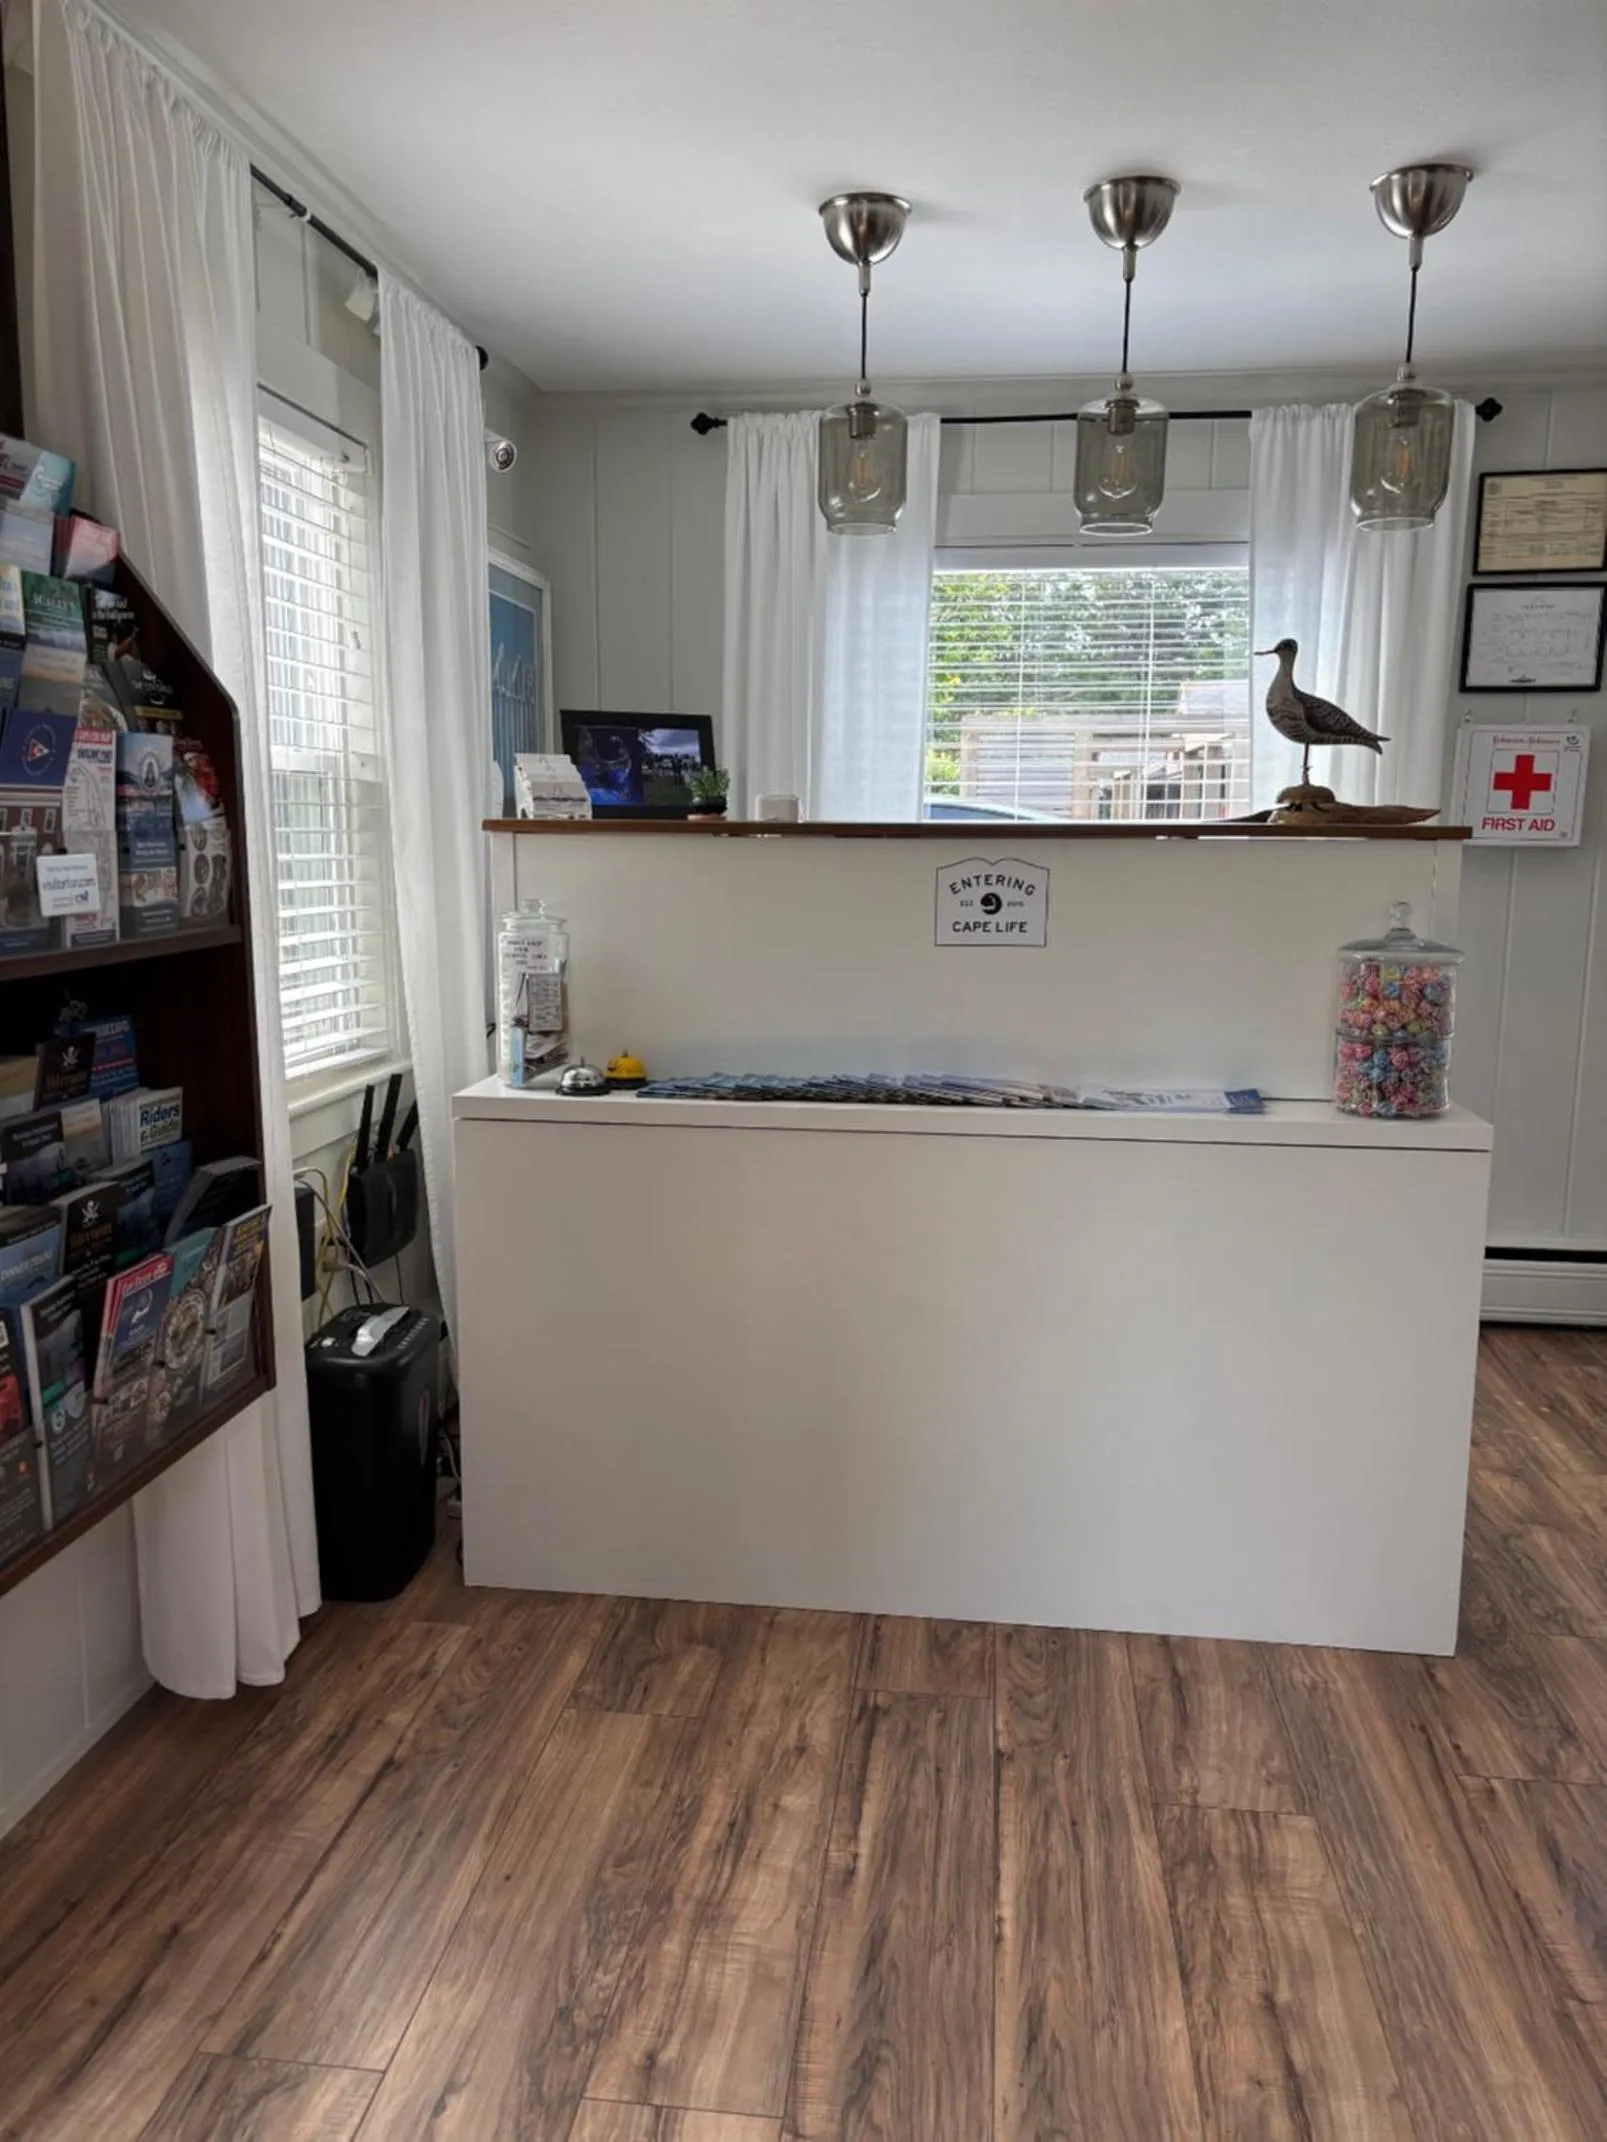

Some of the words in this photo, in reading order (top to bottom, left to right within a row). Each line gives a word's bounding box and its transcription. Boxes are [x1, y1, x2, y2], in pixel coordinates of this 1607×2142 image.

[1481, 817, 1526, 832] FIRST
[1528, 817, 1556, 832] AID
[949, 874, 1037, 896] ENTERING
[952, 921, 992, 933] CAPE
[995, 921, 1028, 933] LIFE
[140, 1104, 181, 1127] Riders
